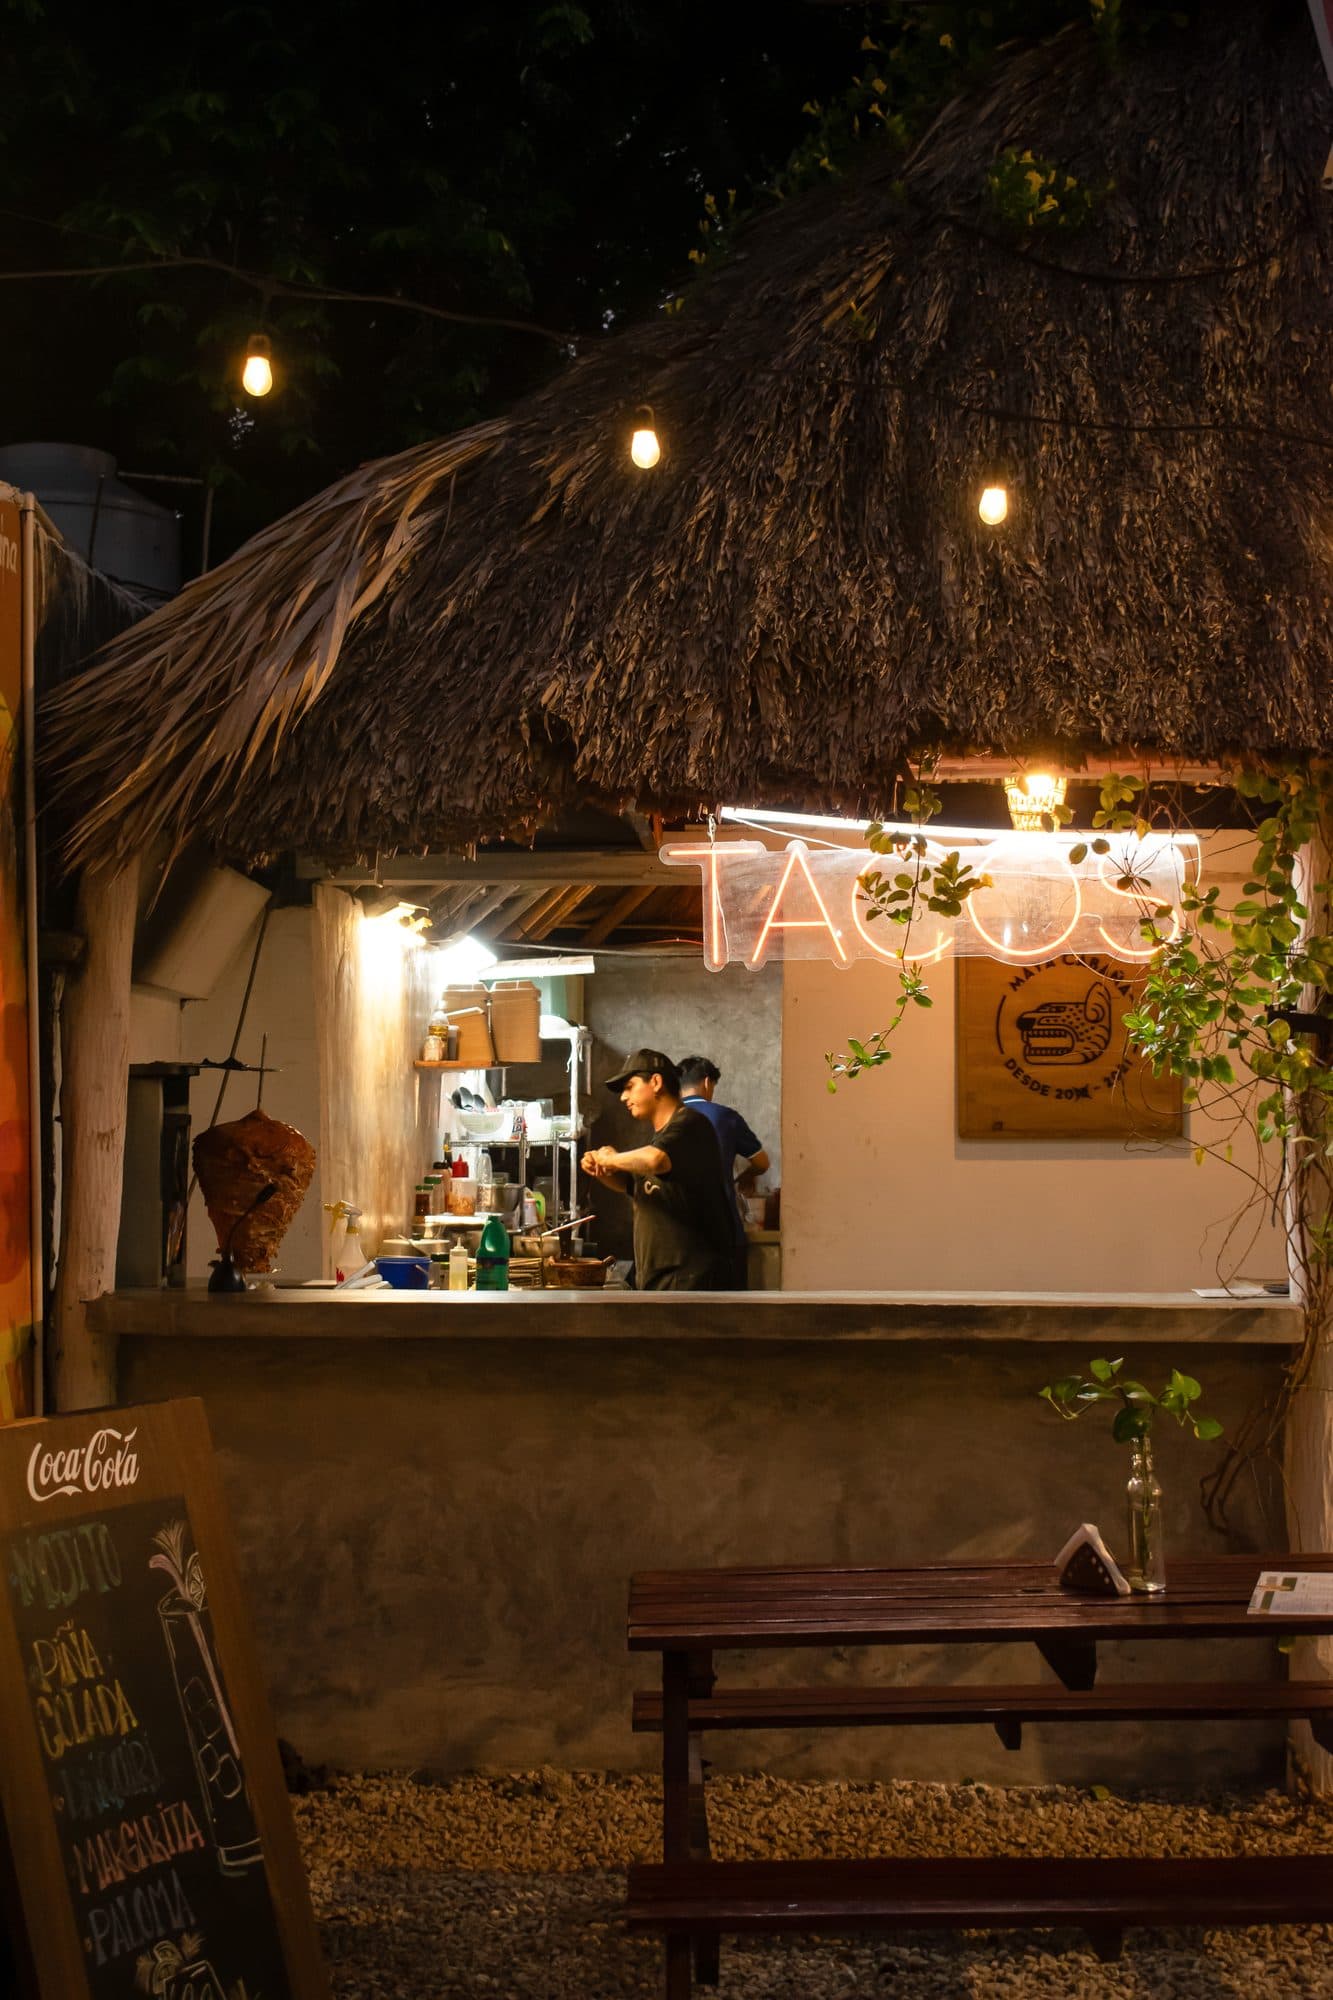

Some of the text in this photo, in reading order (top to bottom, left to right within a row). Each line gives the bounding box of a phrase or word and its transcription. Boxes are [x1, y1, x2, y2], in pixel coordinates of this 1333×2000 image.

[668, 838, 1181, 964] TACOS
[1004, 1058, 1051, 1096] DESDE
[27, 1427, 140, 1502] Coca-Cola
[32, 1618, 105, 1694] PIÑA
[36, 1678, 139, 1758] COLADA
[72, 1799, 205, 1895] MARGARITA
[87, 1867, 198, 1967] PALOMA
